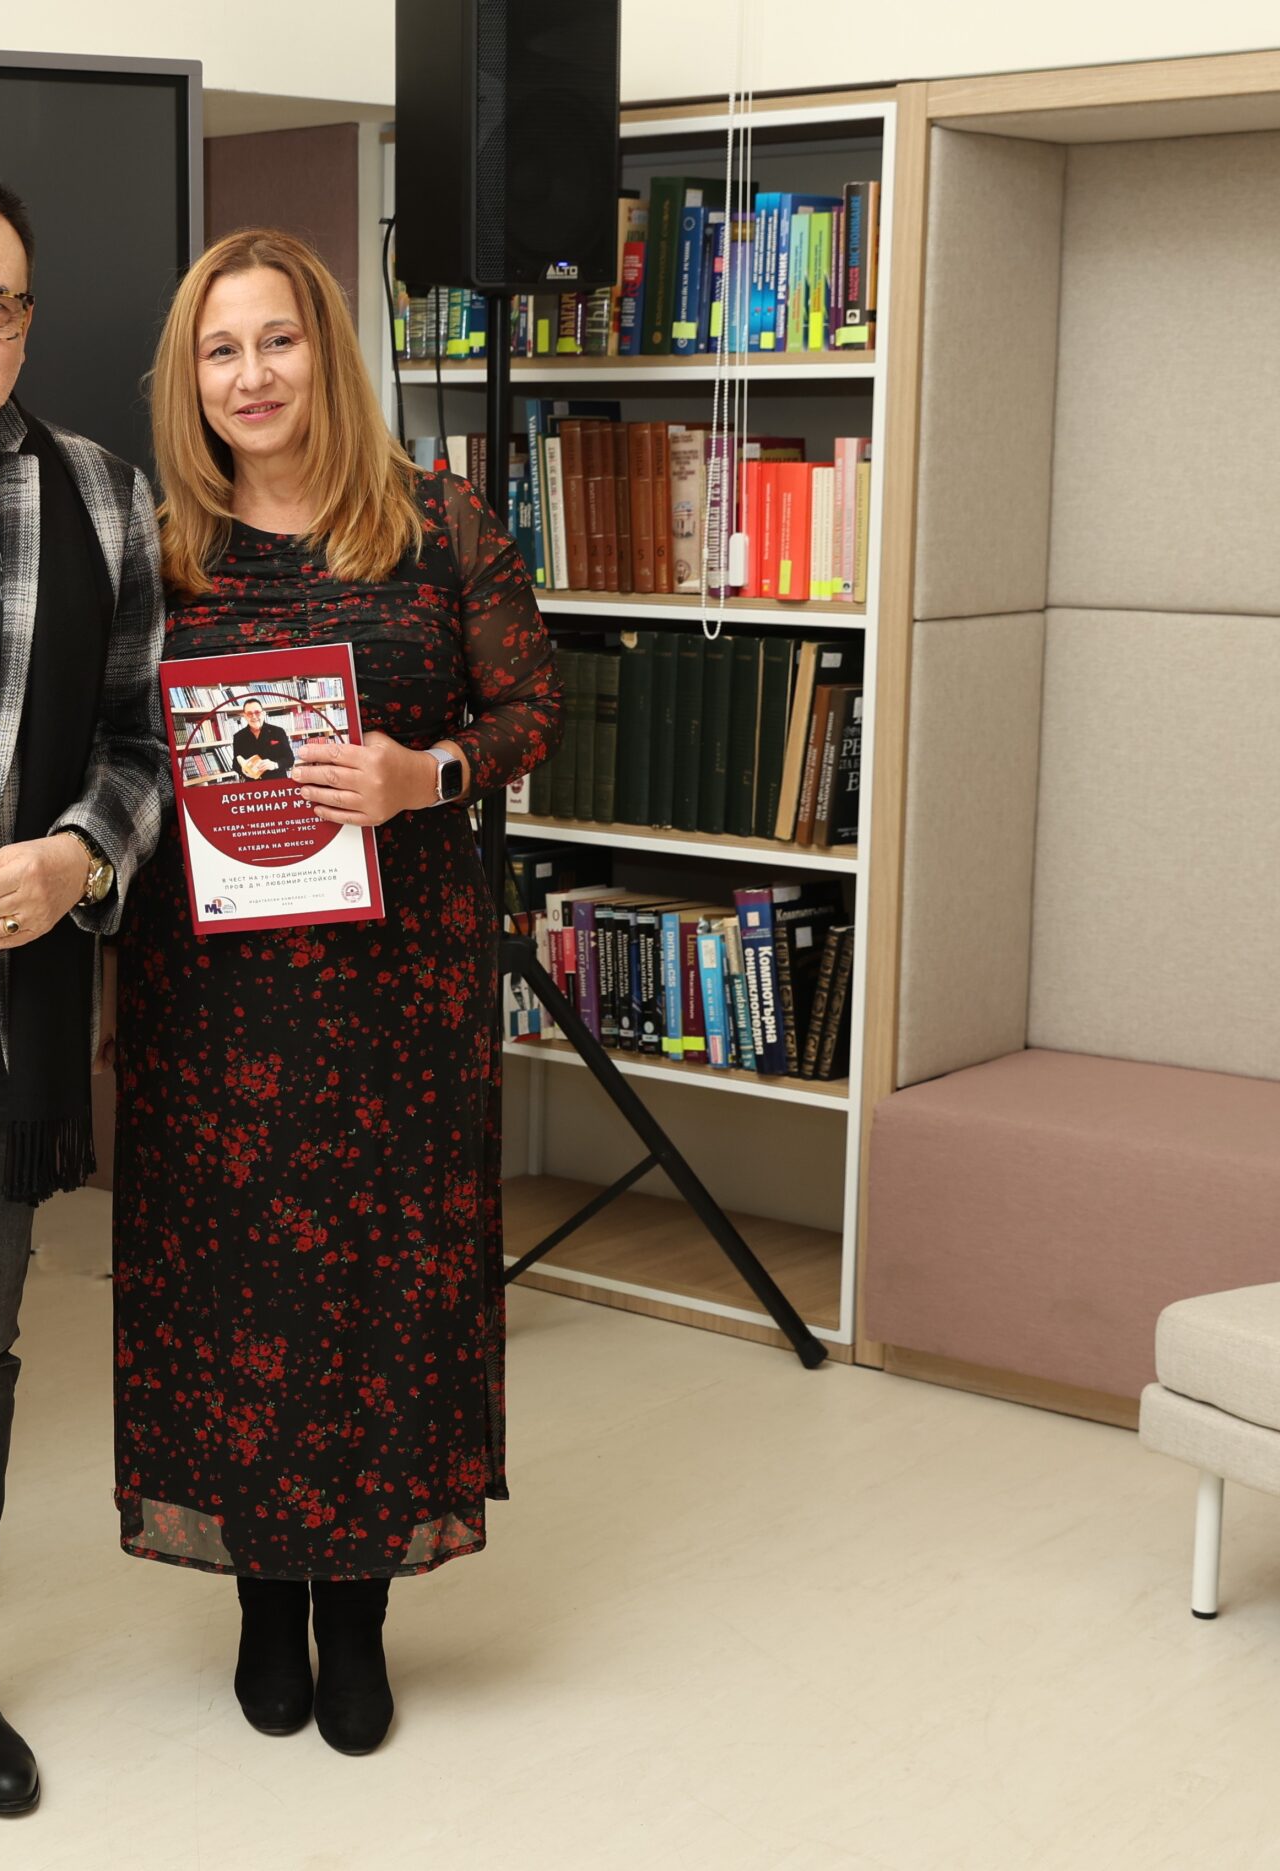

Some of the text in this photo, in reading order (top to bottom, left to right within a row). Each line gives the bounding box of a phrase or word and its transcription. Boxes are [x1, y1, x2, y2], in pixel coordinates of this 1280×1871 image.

[546, 264, 578, 275] ALTO
[777, 252, 788, 300] РЕЧНИК
[657, 545, 664, 557] 6
[231, 801, 288, 814] СЕМИНАР
[232, 828, 289, 838] КОМУНИКАЦИИ"
[577, 930, 585, 951] БАЗИ
[666, 931, 675, 961] DHTML
[687, 935, 697, 966] Linux
[578, 954, 585, 964] ОТ
[667, 969, 676, 987] CSS
[734, 978, 747, 1028] Интернет
[744, 947, 763, 1055] енциклопедия
[758, 946, 777, 1044] Компютърна
